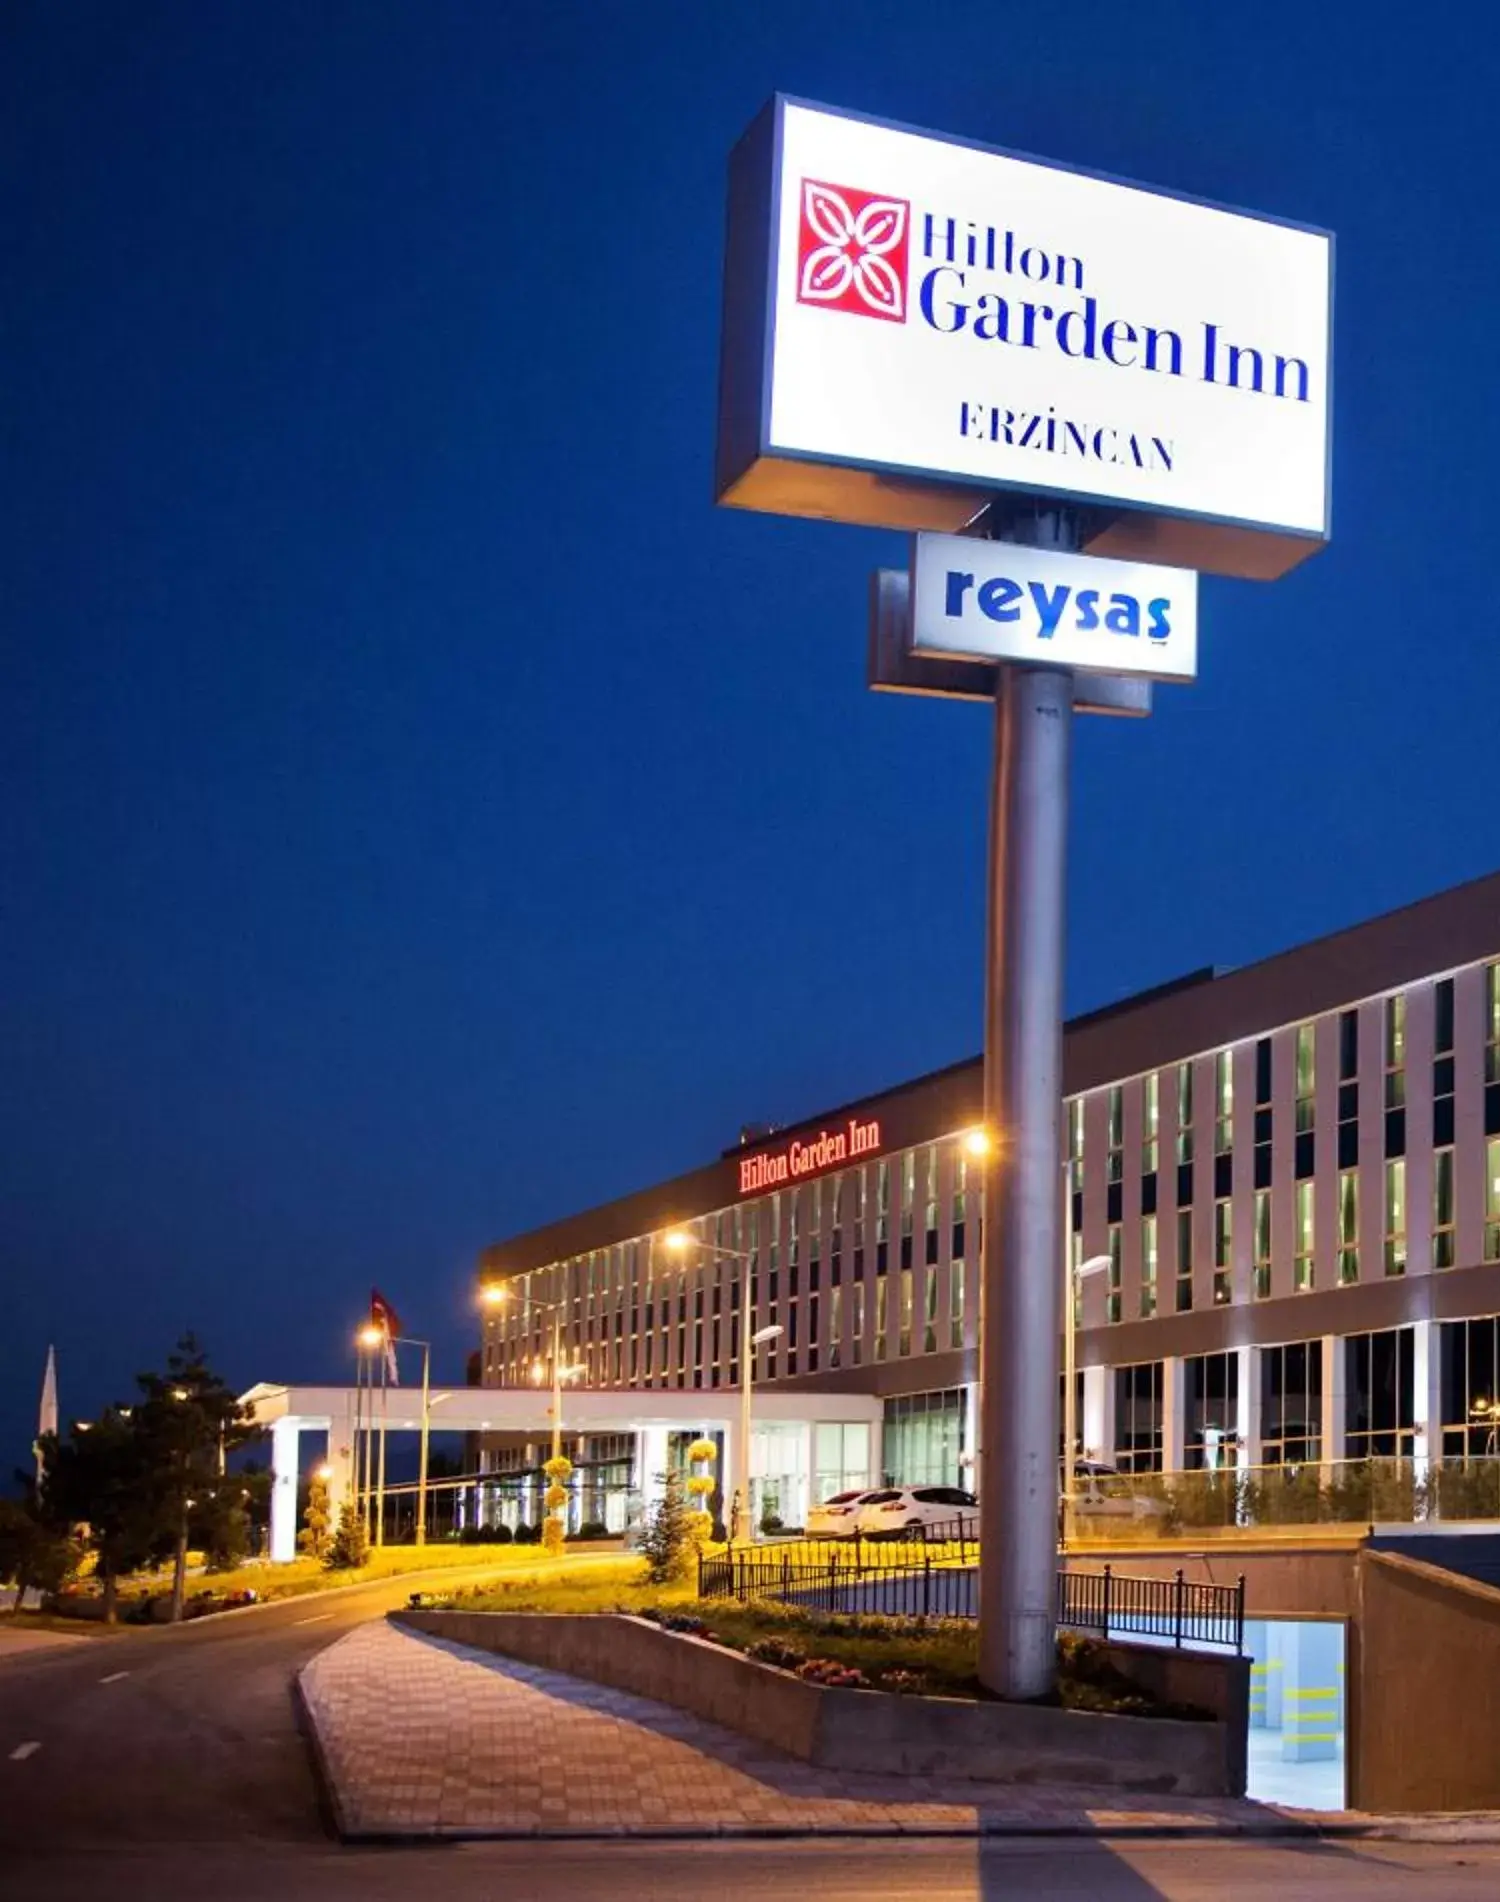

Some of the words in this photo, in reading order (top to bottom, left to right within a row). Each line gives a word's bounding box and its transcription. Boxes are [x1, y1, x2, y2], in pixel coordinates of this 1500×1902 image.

[924, 213, 1083, 290] Hilton
[920, 266, 1182, 377] Garden
[1199, 322, 1310, 402] Inn
[740, 1152, 787, 1192] Hilton
[790, 1131, 846, 1176] Garden
[849, 1120, 880, 1156] Inn
